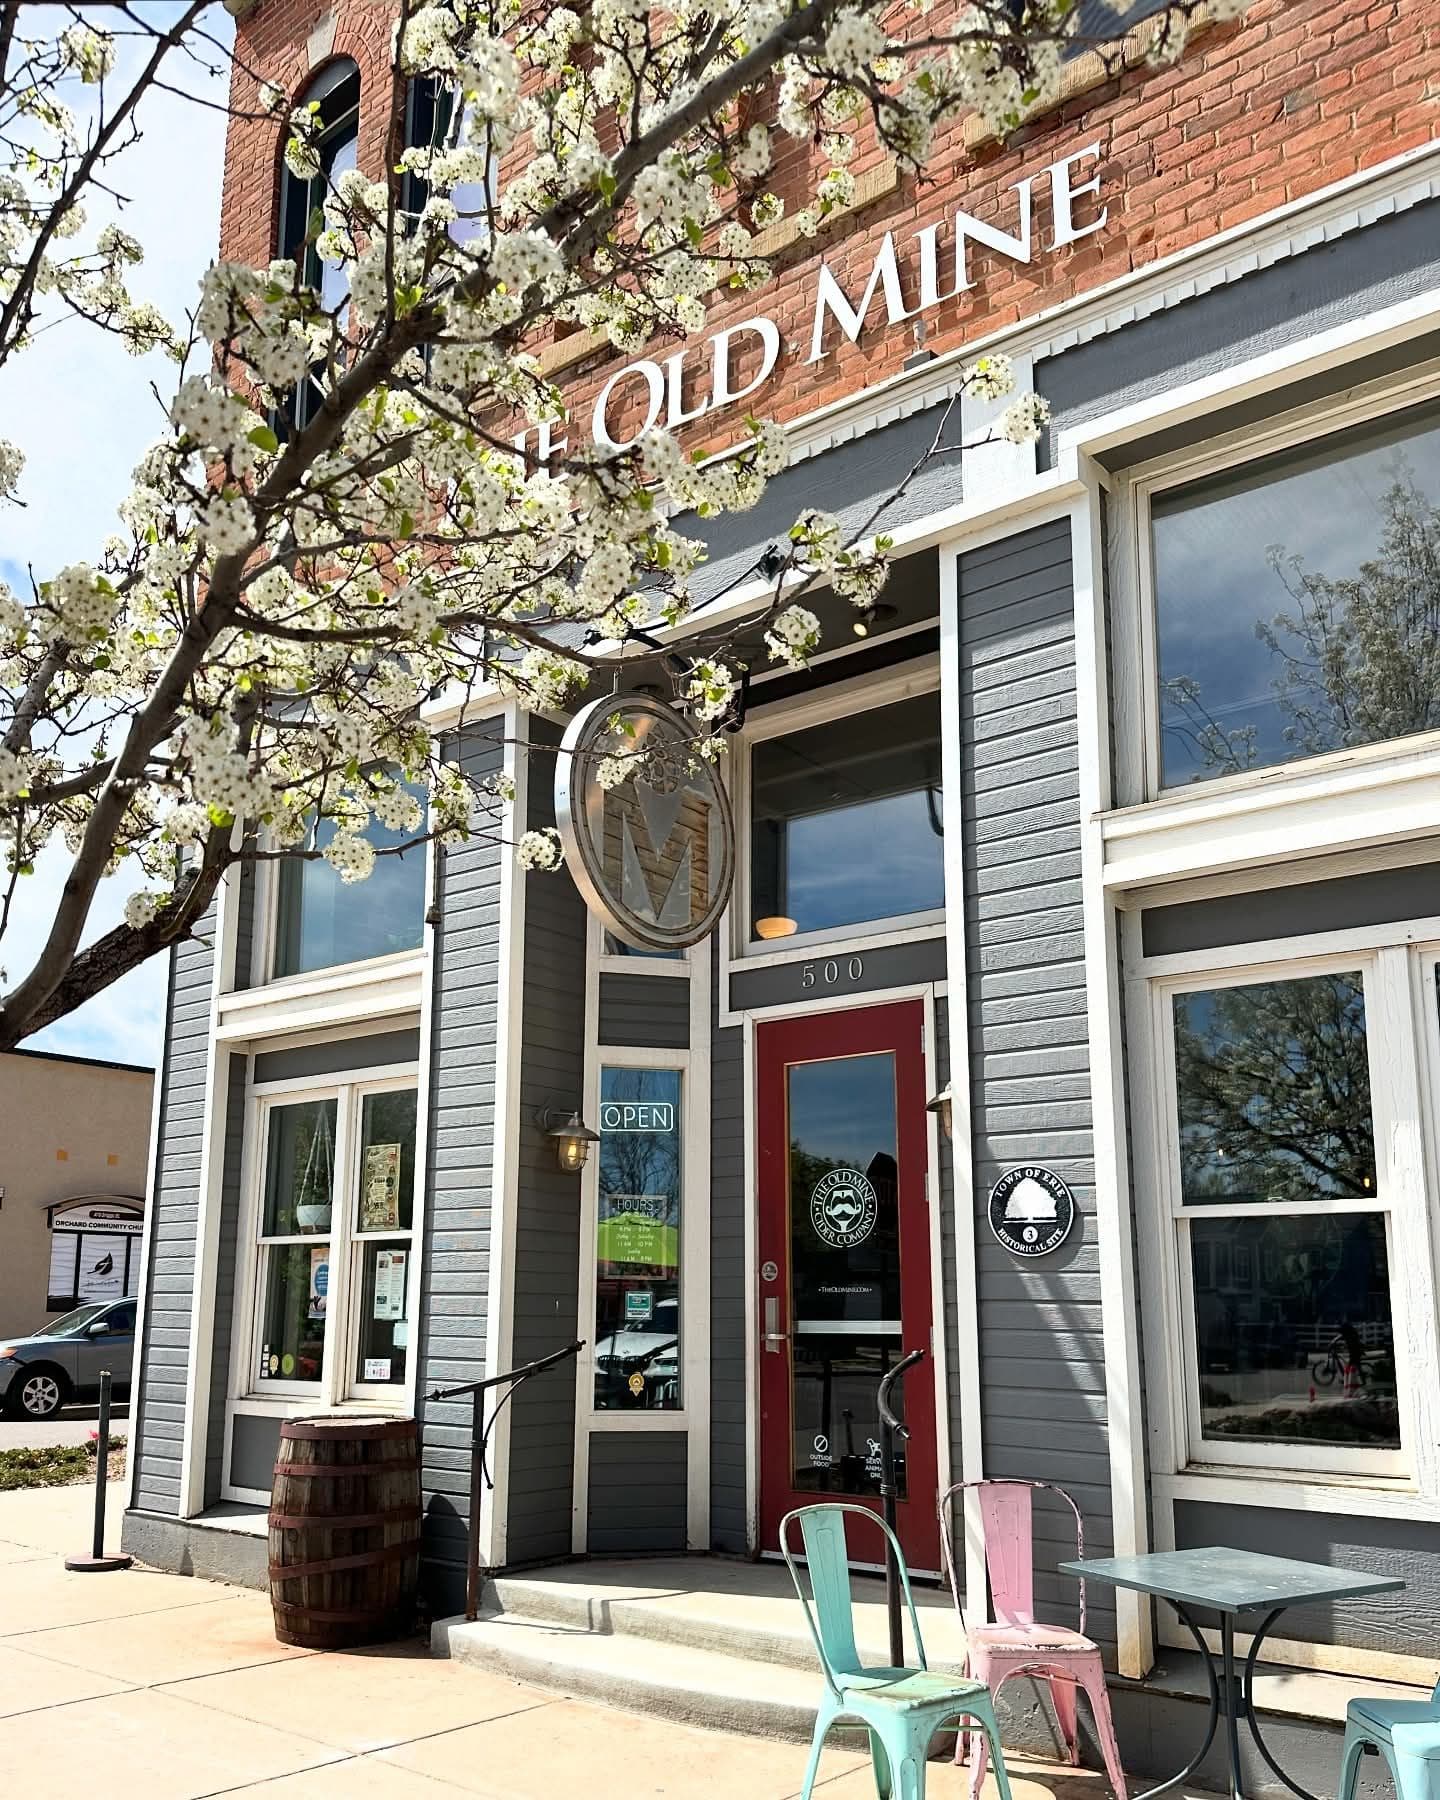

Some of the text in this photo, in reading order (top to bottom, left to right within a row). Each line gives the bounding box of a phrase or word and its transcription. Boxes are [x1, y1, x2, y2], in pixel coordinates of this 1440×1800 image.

[592, 316, 780, 452] OLD
[803, 140, 1108, 367] MINE
[802, 957, 863, 988] 500
[604, 1106, 668, 1129] OPEN
[813, 1171, 875, 1207] THE OLD MINE
[995, 1168, 1066, 1198] TOWN OF ERIE
[617, 1199, 654, 1211] HOURS
[55, 1220, 88, 1228] ORCHARD
[88, 1222, 127, 1230] COMMUNITY
[814, 1208, 875, 1245] CIDER COMPANY
[1026, 1230, 1034, 1240] 3
[998, 1227, 1064, 1253] HISTORICAL SITE
